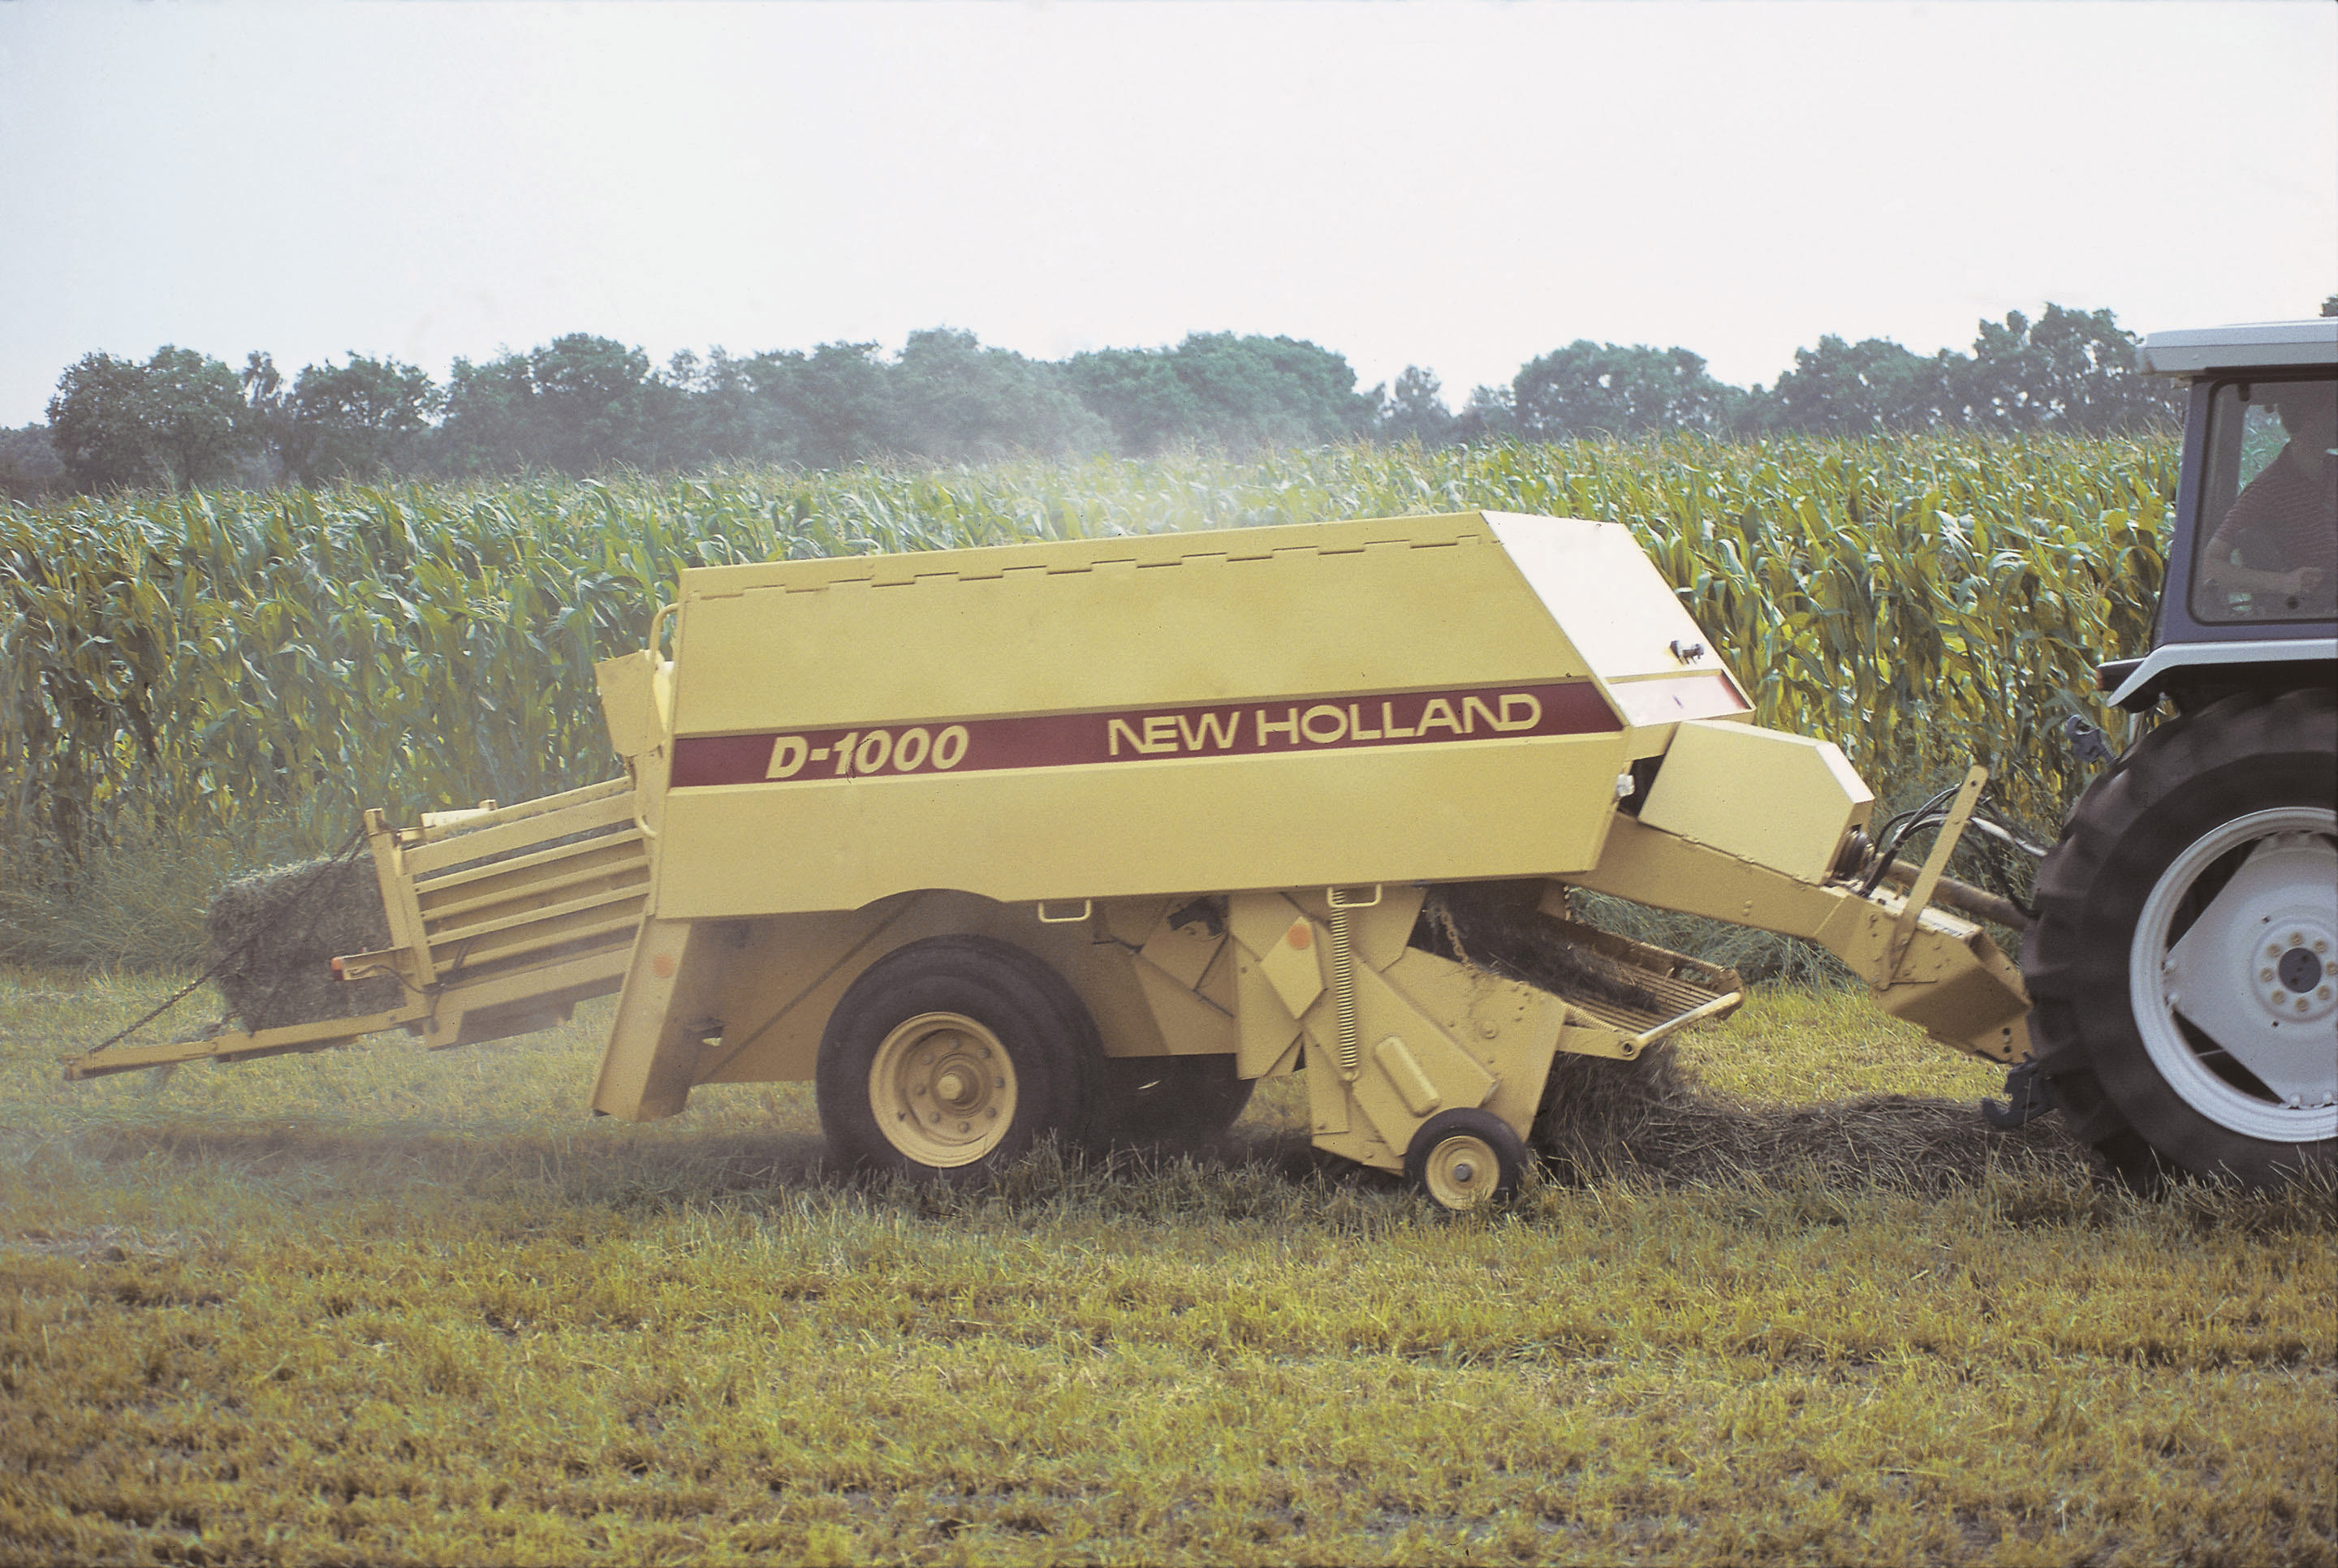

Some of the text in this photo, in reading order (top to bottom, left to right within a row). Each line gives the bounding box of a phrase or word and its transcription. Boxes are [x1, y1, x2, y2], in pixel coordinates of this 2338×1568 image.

[765, 725, 970, 780] D-1000
[1107, 693, 1542, 756] NEW HOLLAND
